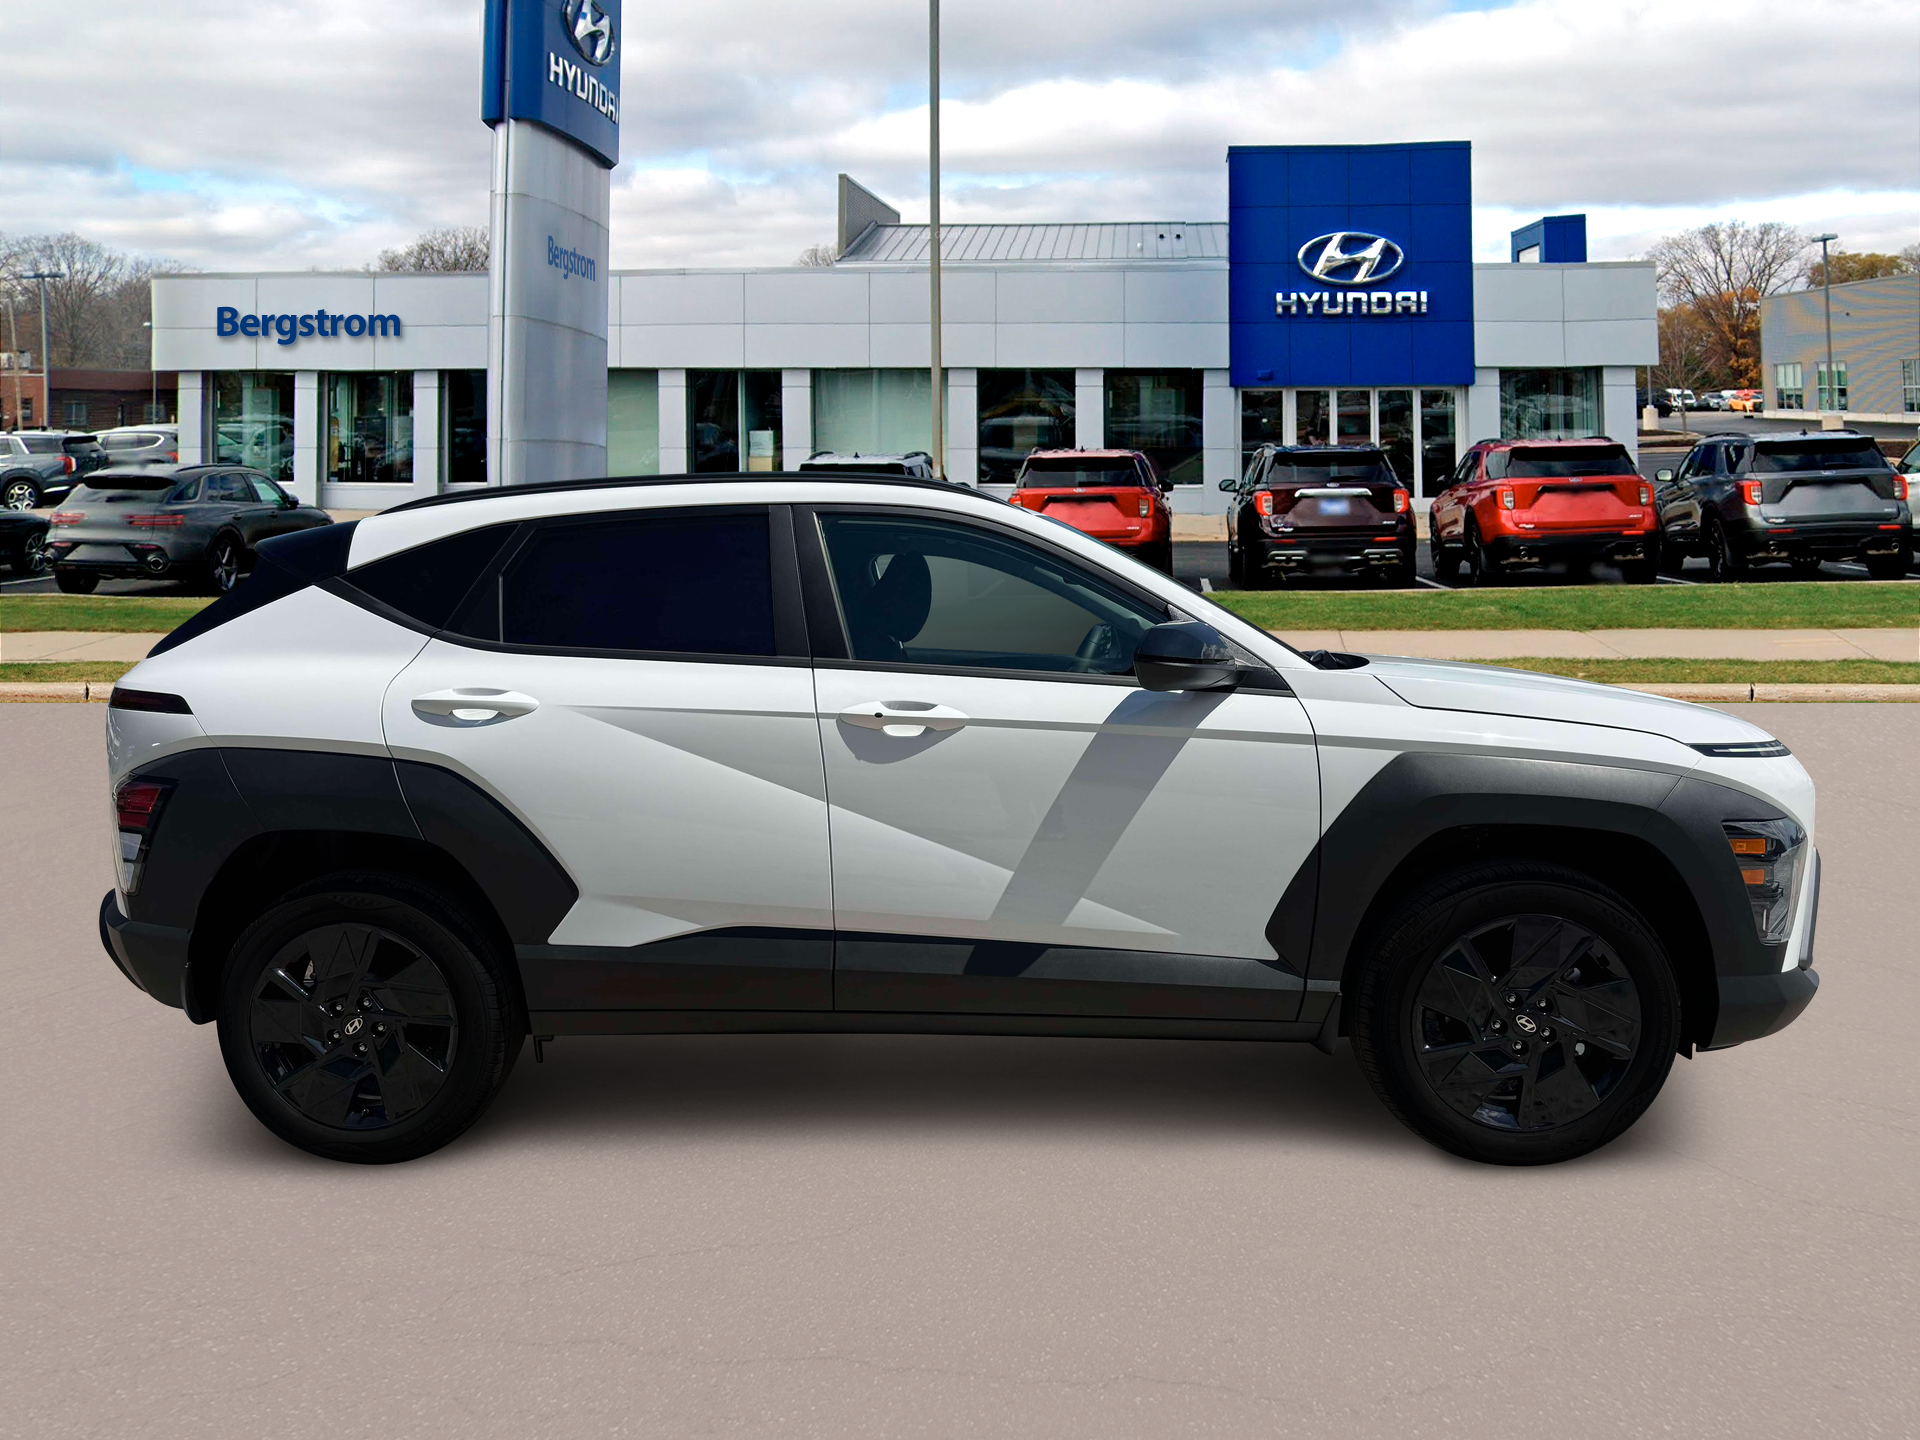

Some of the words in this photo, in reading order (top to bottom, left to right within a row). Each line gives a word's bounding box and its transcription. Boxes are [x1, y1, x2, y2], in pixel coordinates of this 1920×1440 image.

[549, 51, 619, 124] HYUNDAI
[547, 235, 596, 282] Bergstrom
[1275, 291, 1428, 315] HYUNDAI
[217, 306, 402, 346] Bergstrom
[1477, 887, 1561, 909] KUMHO
